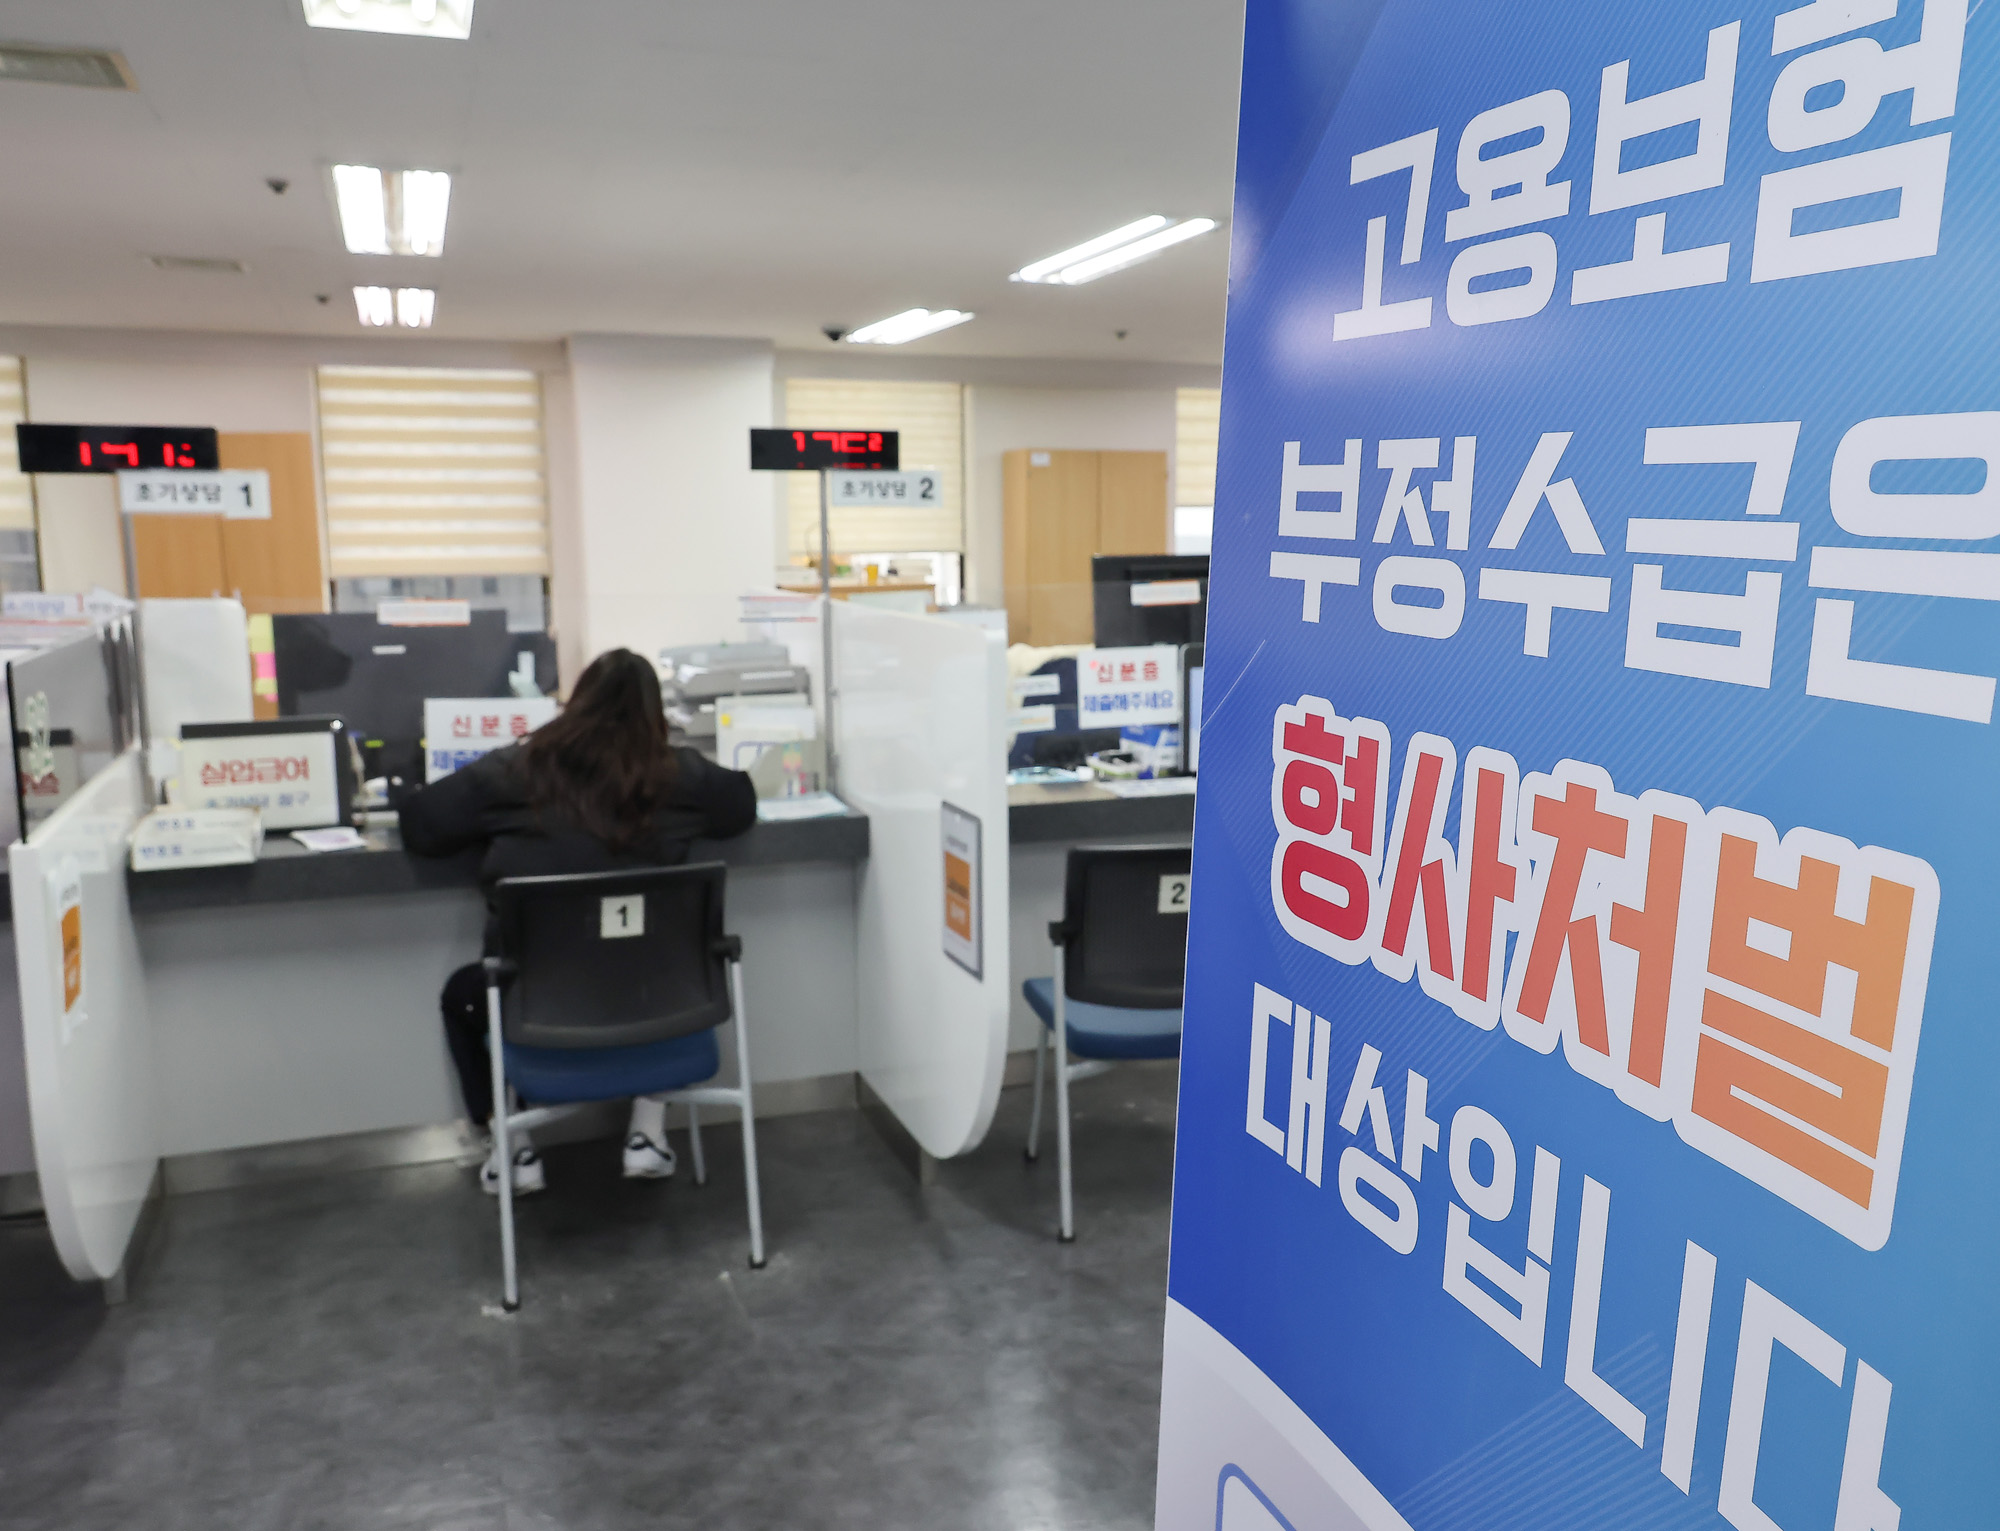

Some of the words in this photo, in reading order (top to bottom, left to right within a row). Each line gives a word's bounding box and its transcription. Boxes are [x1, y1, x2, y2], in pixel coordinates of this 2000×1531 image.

[1332, 0, 1968, 342] 고용보험
[240, 483, 252, 507] 1
[920, 478, 934, 499] 2
[1269, 410, 2000, 724] 부정수급은
[201, 757, 310, 786] 실업급여
[1171, 882, 1186, 905] 2
[617, 904, 628, 927] 1
[1281, 712, 1916, 1212] 형사처벌
[1245, 982, 1902, 1531] 대상입니다
